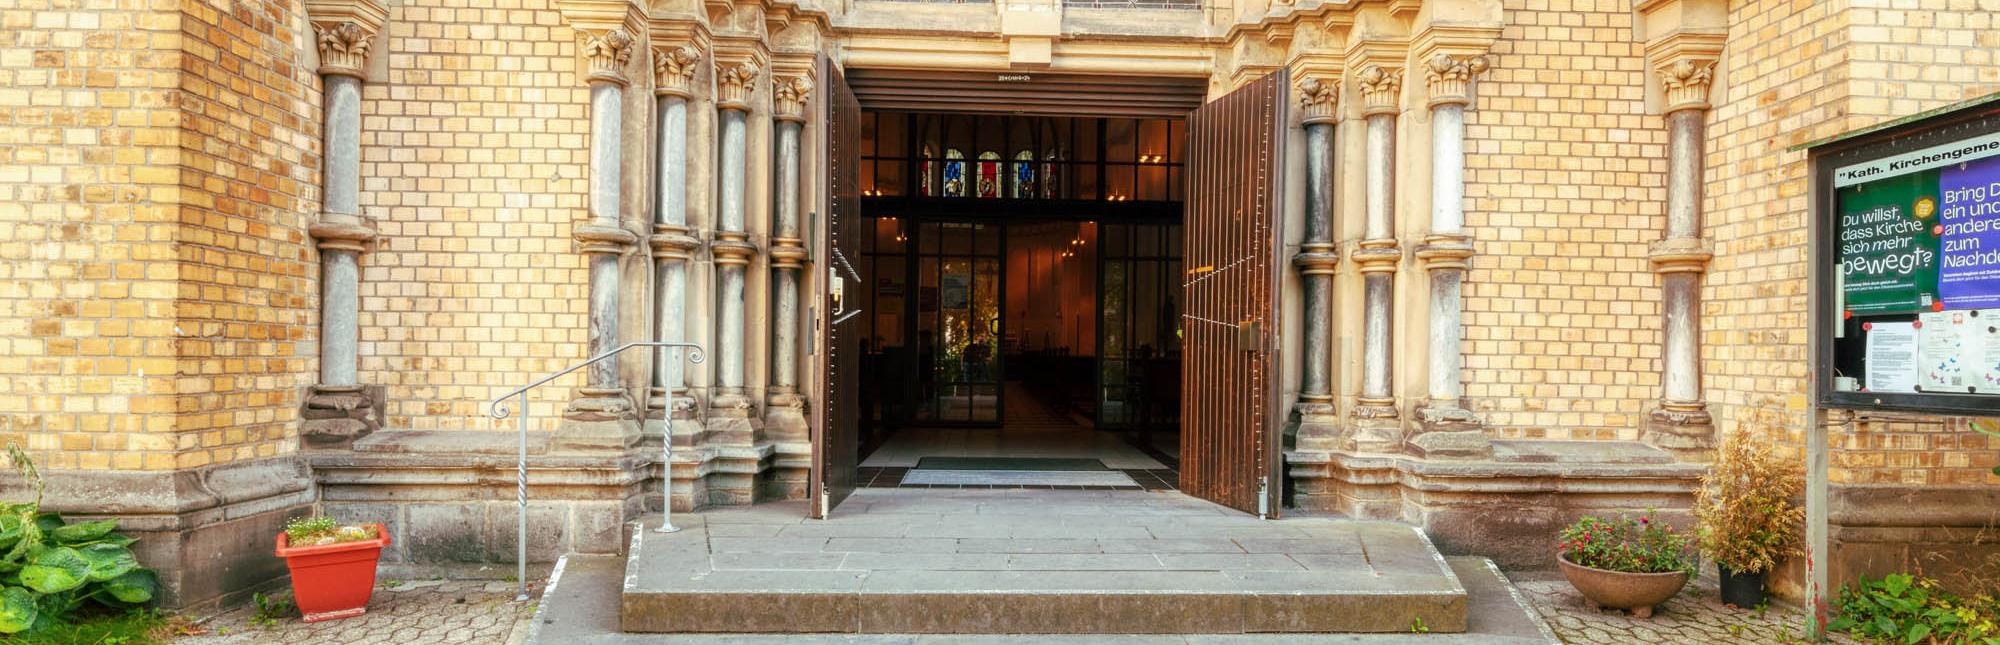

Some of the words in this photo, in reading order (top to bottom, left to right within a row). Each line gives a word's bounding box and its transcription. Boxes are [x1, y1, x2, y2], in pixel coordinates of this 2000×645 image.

[1889, 140, 2000, 172] Kirchengeme
[1945, 186, 1986, 204] Bring
[1842, 215, 1859, 227] Du
[1862, 206, 1900, 224] willst,
[1943, 204, 1966, 220] ein
[1841, 228, 1874, 241] dass
[1876, 220, 1924, 236] Kirche
[1944, 218, 2000, 236] andere
[1842, 240, 1870, 255] sich
[1872, 235, 1913, 251] mehr
[1944, 237, 1980, 252] zum
[1841, 247, 1933, 275] bewegt?
